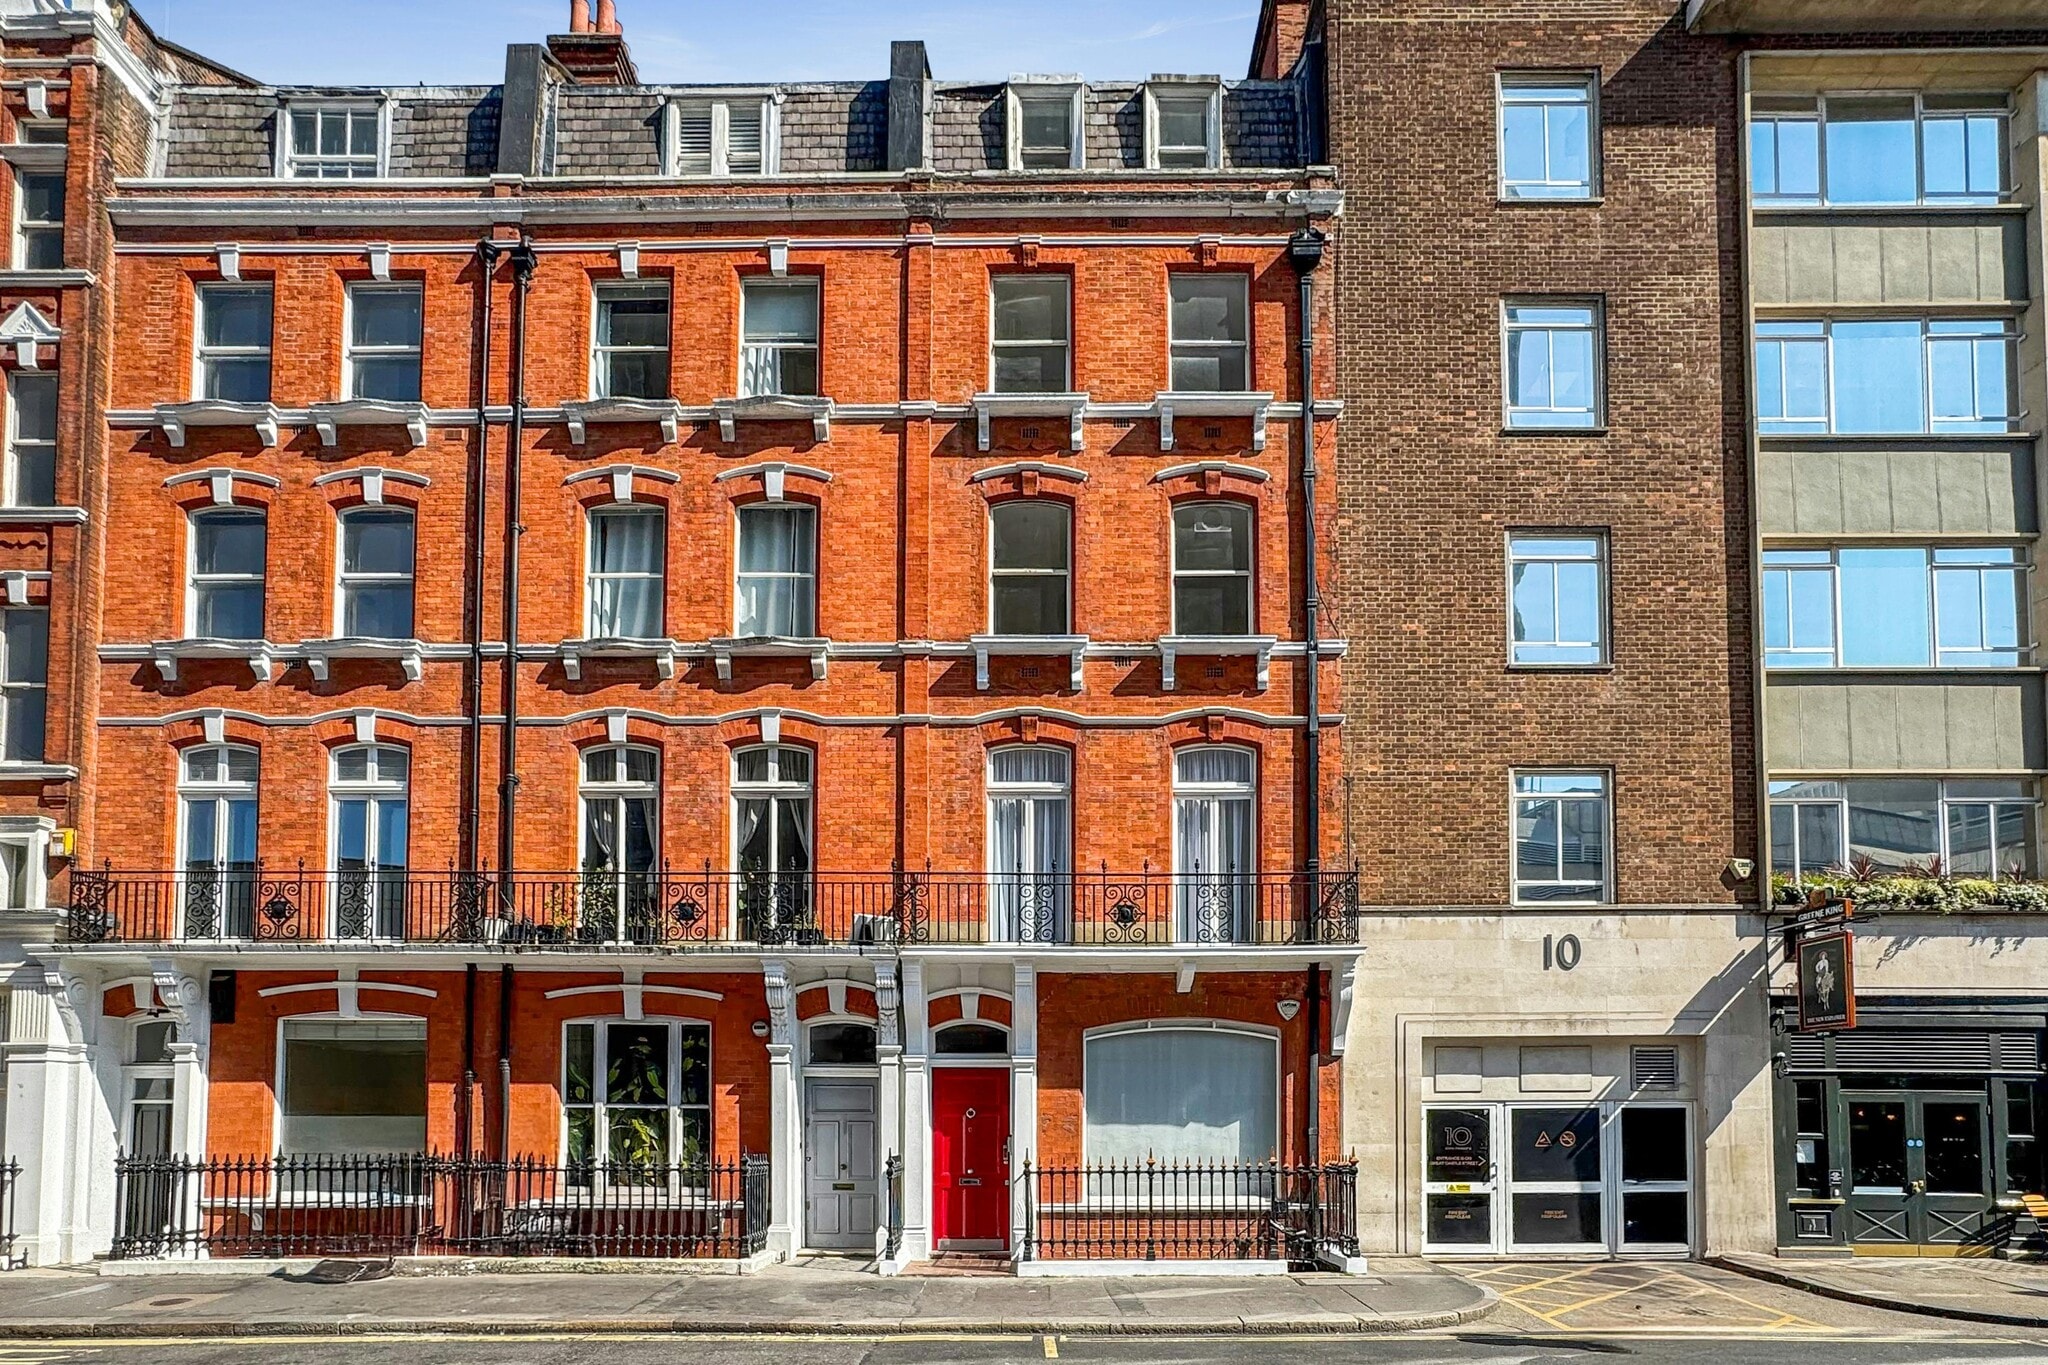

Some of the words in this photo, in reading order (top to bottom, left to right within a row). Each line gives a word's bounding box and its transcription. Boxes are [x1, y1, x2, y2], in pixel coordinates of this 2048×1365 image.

[1797, 908, 1825, 921] GREENE
[1825, 904, 1844, 916] KING
[1543, 933, 1582, 971] 10
[1444, 1126, 1473, 1146] 10
